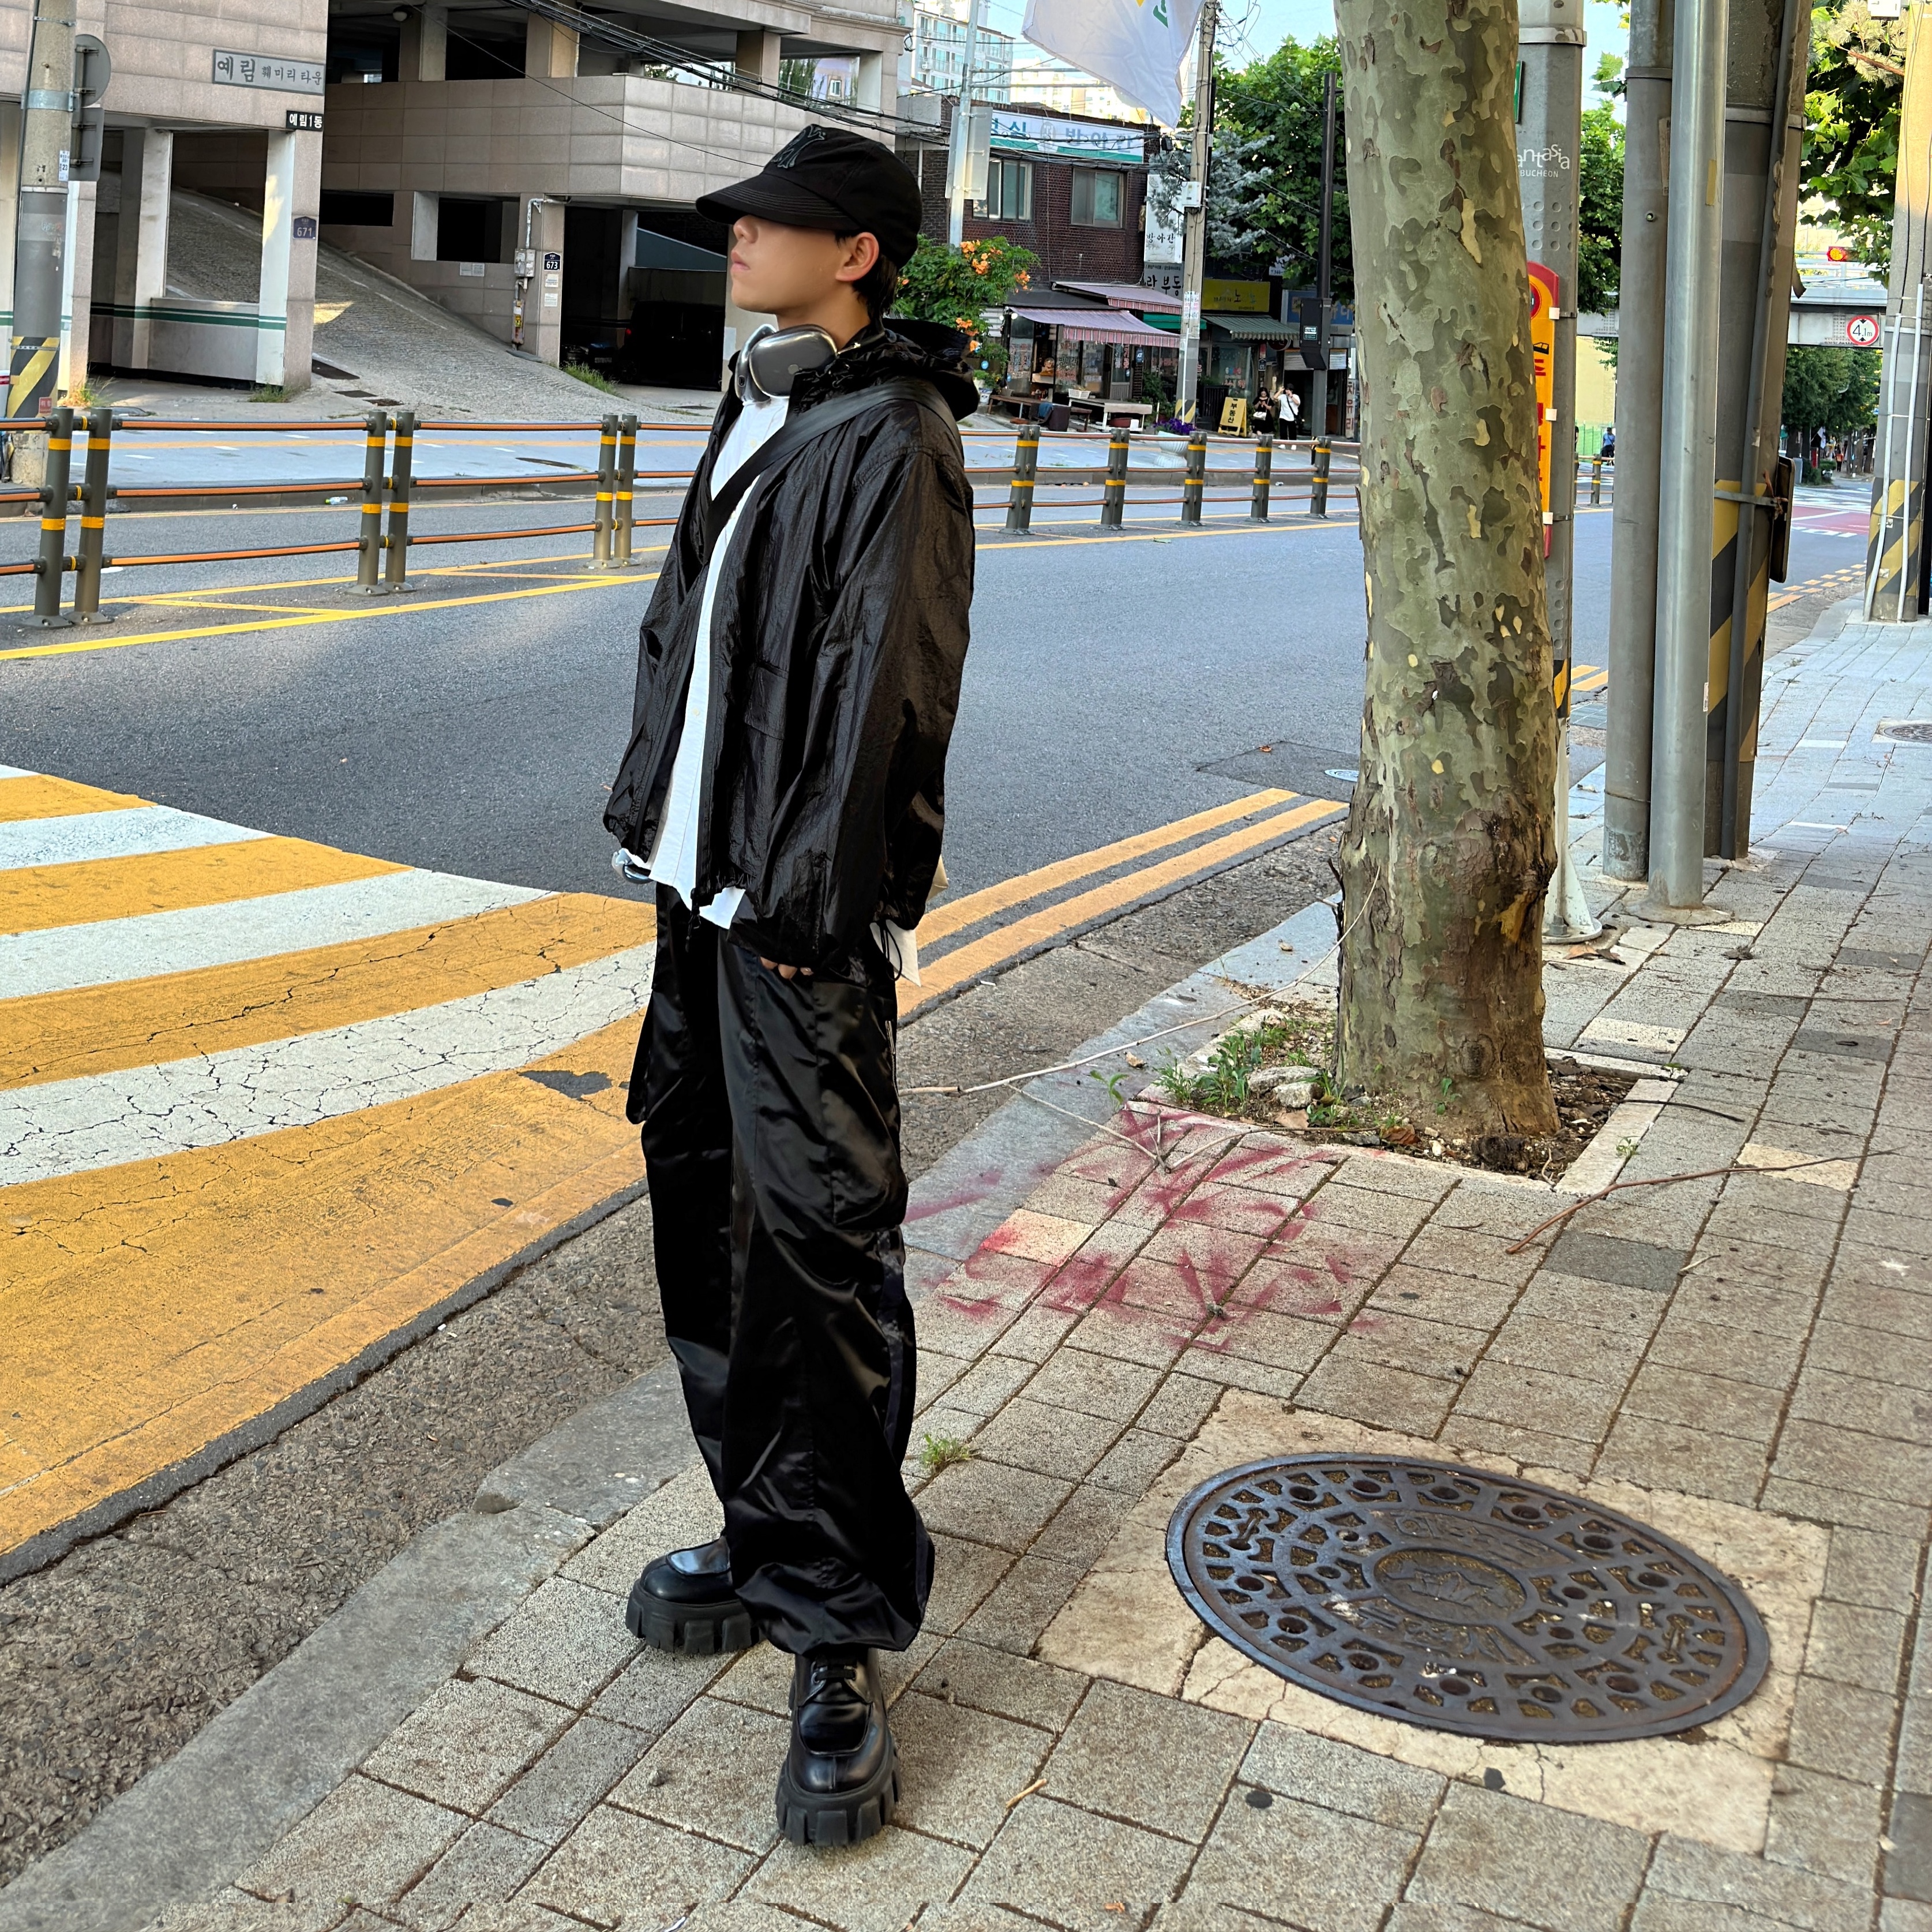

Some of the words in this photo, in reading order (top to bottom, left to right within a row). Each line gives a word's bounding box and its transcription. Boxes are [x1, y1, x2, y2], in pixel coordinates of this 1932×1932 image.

[217, 56, 256, 82] 예림
[289, 113, 323, 129] 예림1동
[1517, 144, 1570, 170] antasia
[1520, 169, 1559, 178] BUCHEON
[297, 227, 312, 237] 671
[546, 261, 558, 269] 673
[1852, 324, 1873, 336] 4.1m
[1228, 402, 1238, 424] 부동산
